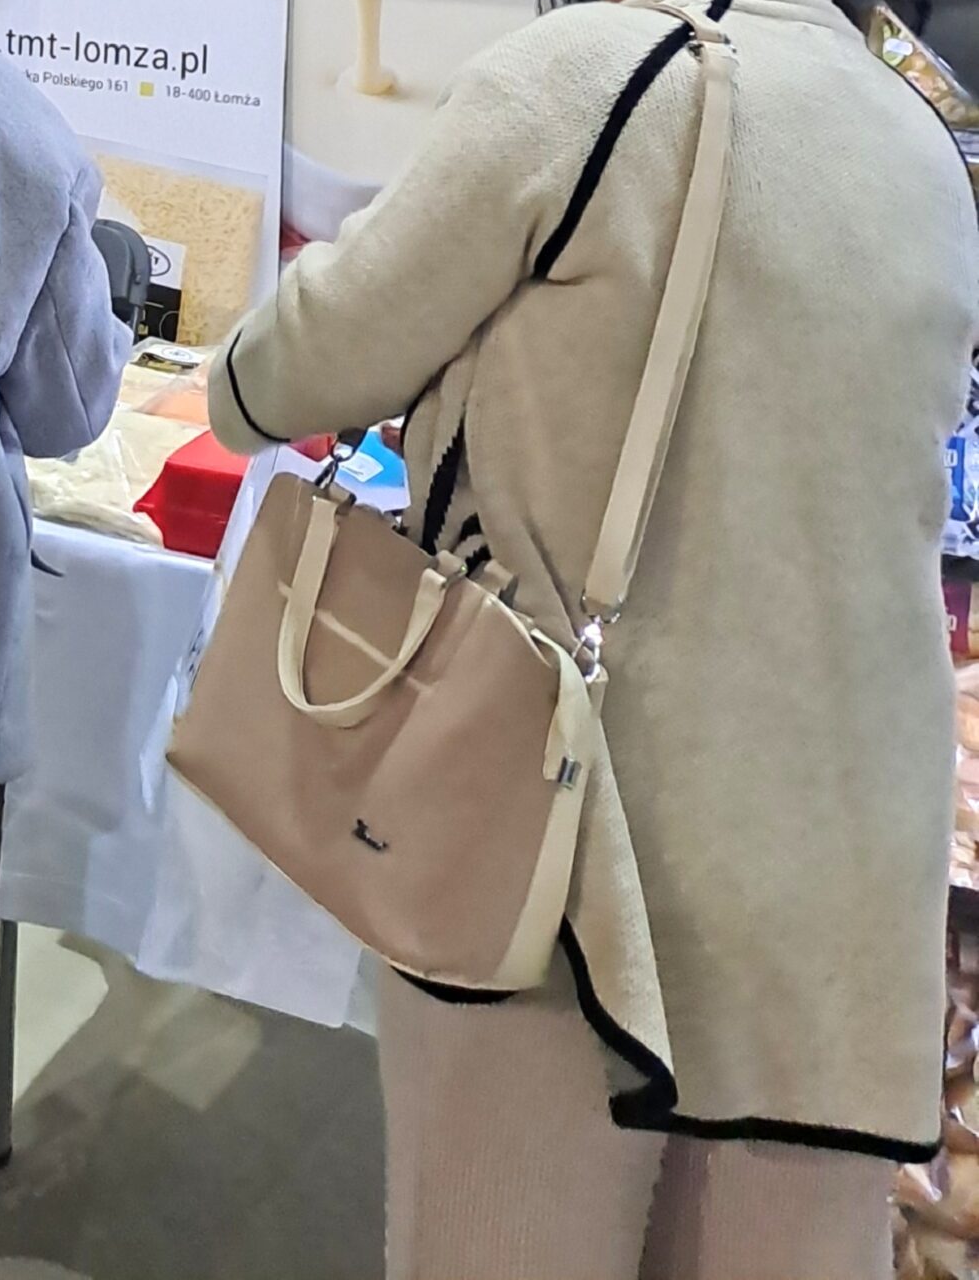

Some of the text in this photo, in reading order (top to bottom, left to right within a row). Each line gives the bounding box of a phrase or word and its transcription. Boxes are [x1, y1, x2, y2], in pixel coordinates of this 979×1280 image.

[25, 70, 262, 107] ka Polskiego 161 18-400 Łomża
